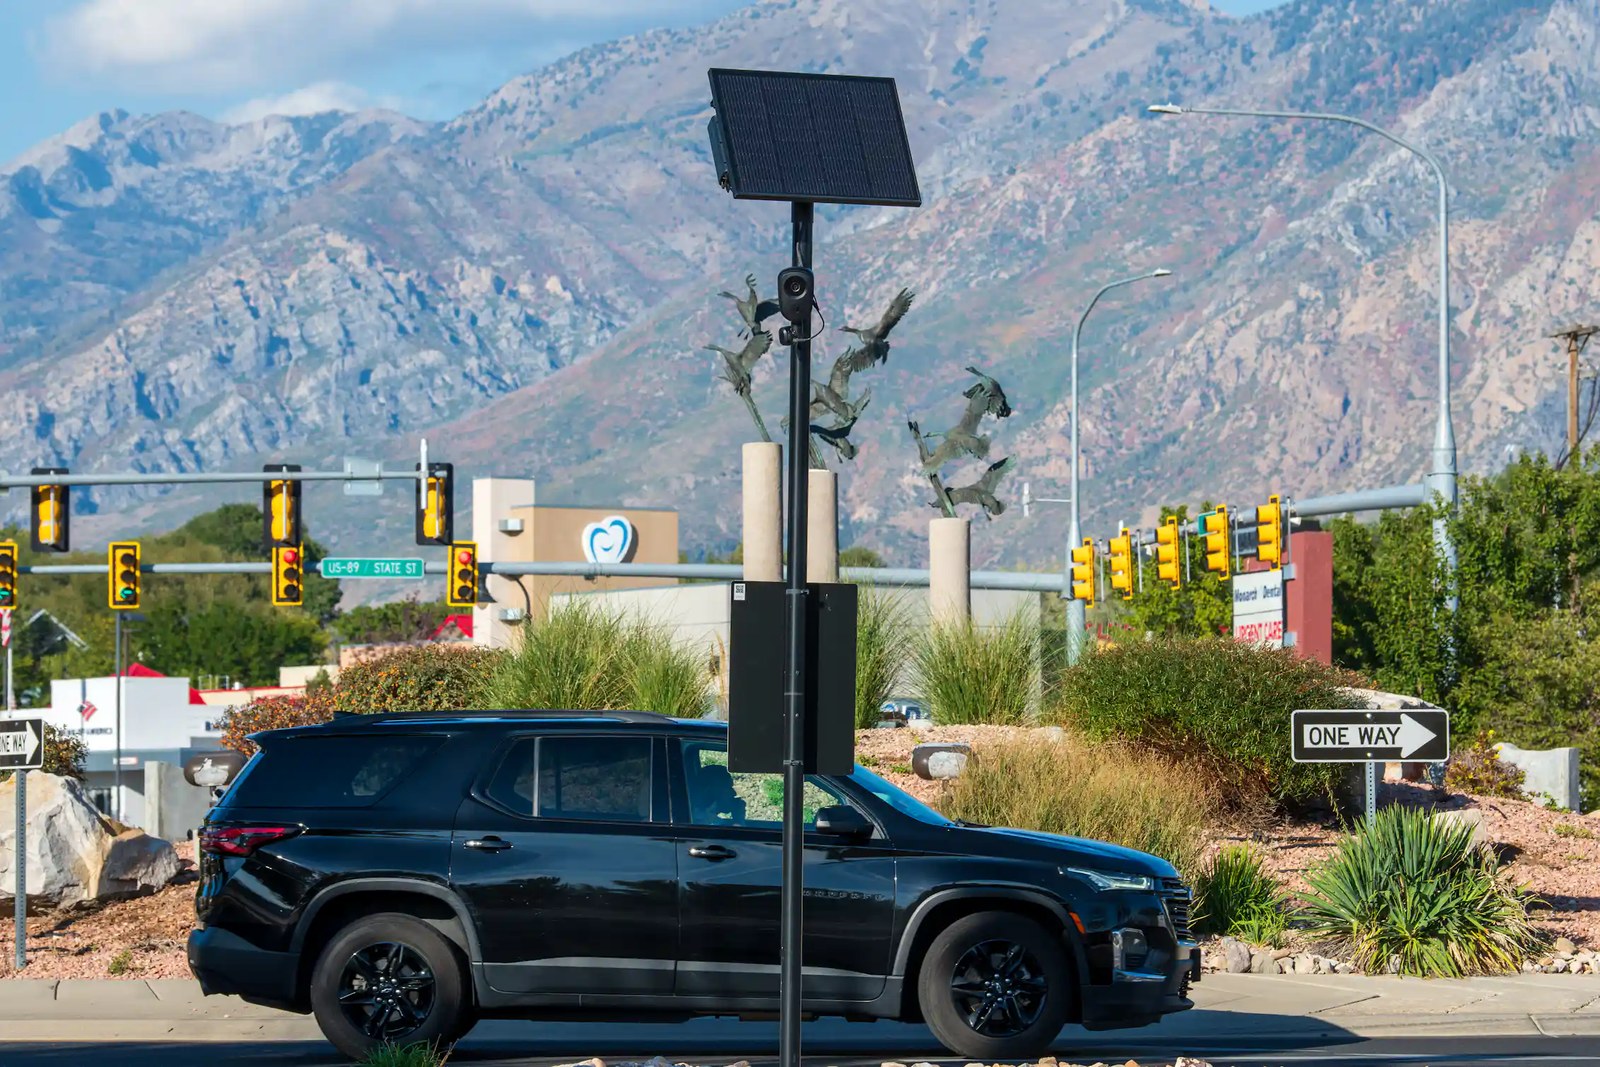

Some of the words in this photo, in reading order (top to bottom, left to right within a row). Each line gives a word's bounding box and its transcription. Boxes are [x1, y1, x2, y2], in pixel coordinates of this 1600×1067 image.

[328, 562, 360, 574] US-89
[374, 562, 401, 574] STATE
[405, 562, 417, 574] ST
[1264, 621, 1283, 641] CARE
[0, 735, 10, 753] NE
[12, 734, 27, 752] WAY
[1308, 726, 1350, 746] ONE
[1358, 726, 1401, 746] WAY
